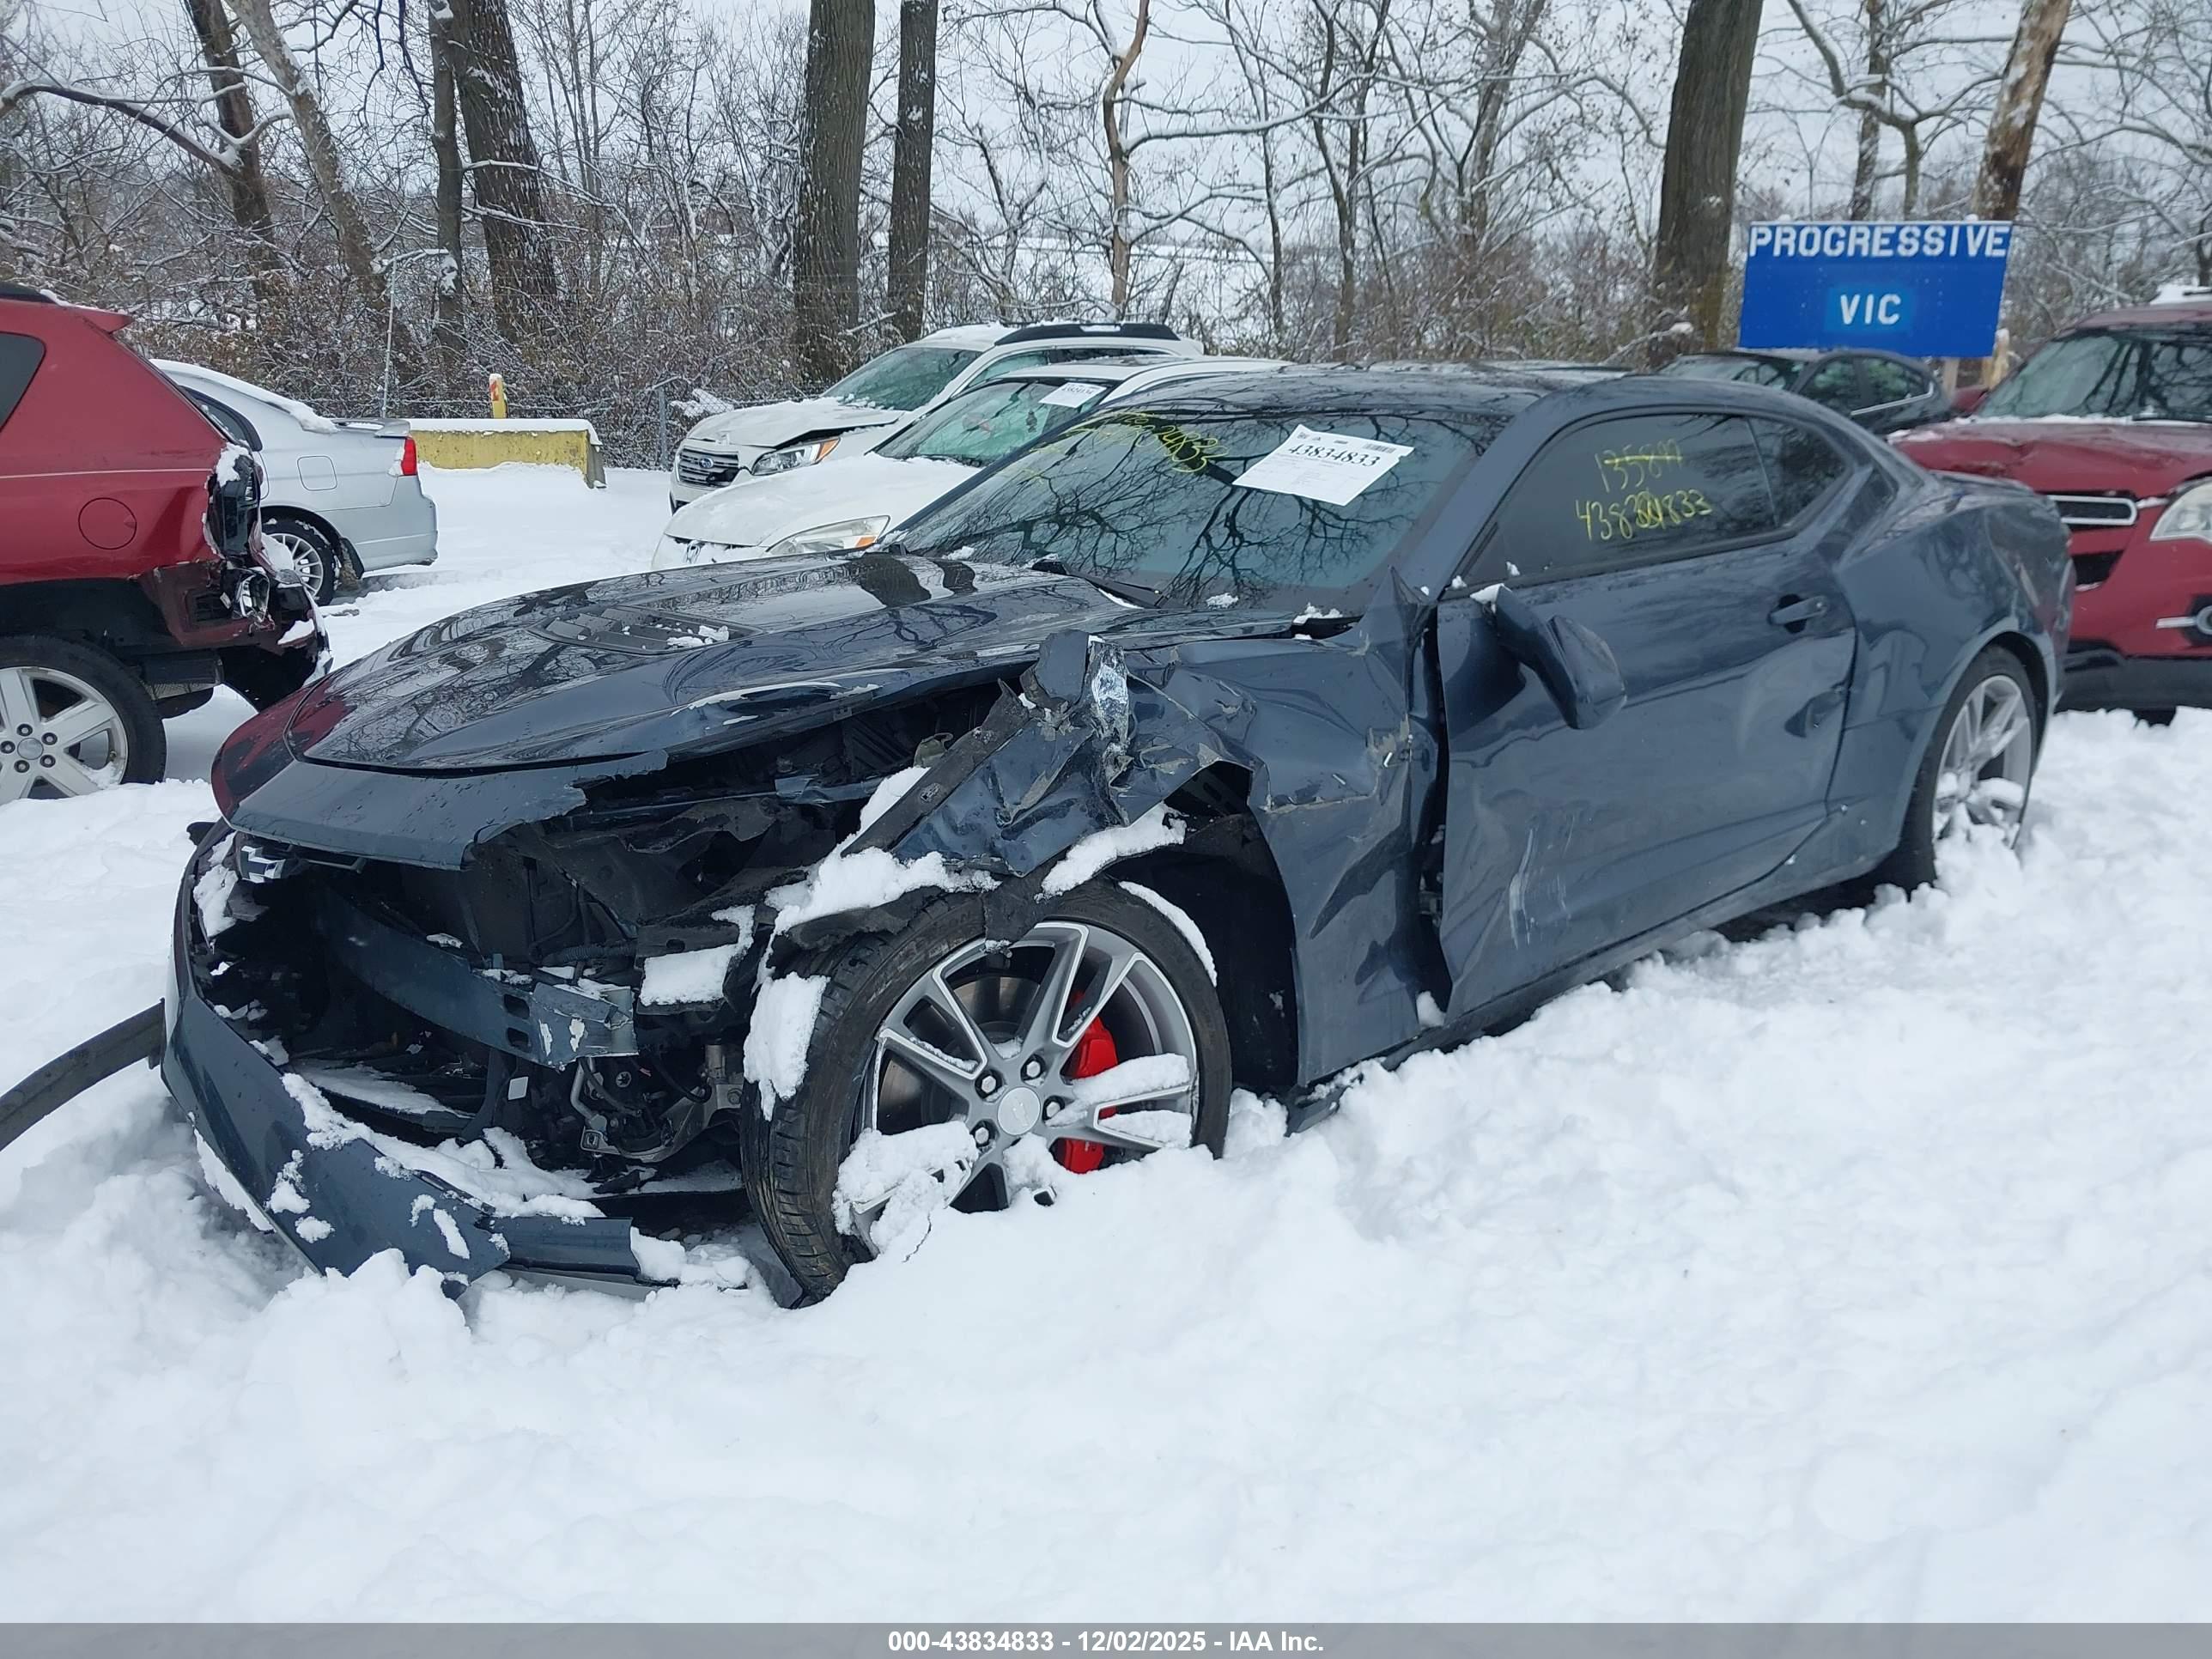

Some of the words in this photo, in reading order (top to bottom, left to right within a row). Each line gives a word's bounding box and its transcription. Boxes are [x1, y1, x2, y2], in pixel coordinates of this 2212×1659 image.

[1749, 225, 2010, 258] PROGRESSIVE
[1841, 294, 1901, 325] VIC
[1288, 443, 1381, 466] 43834833
